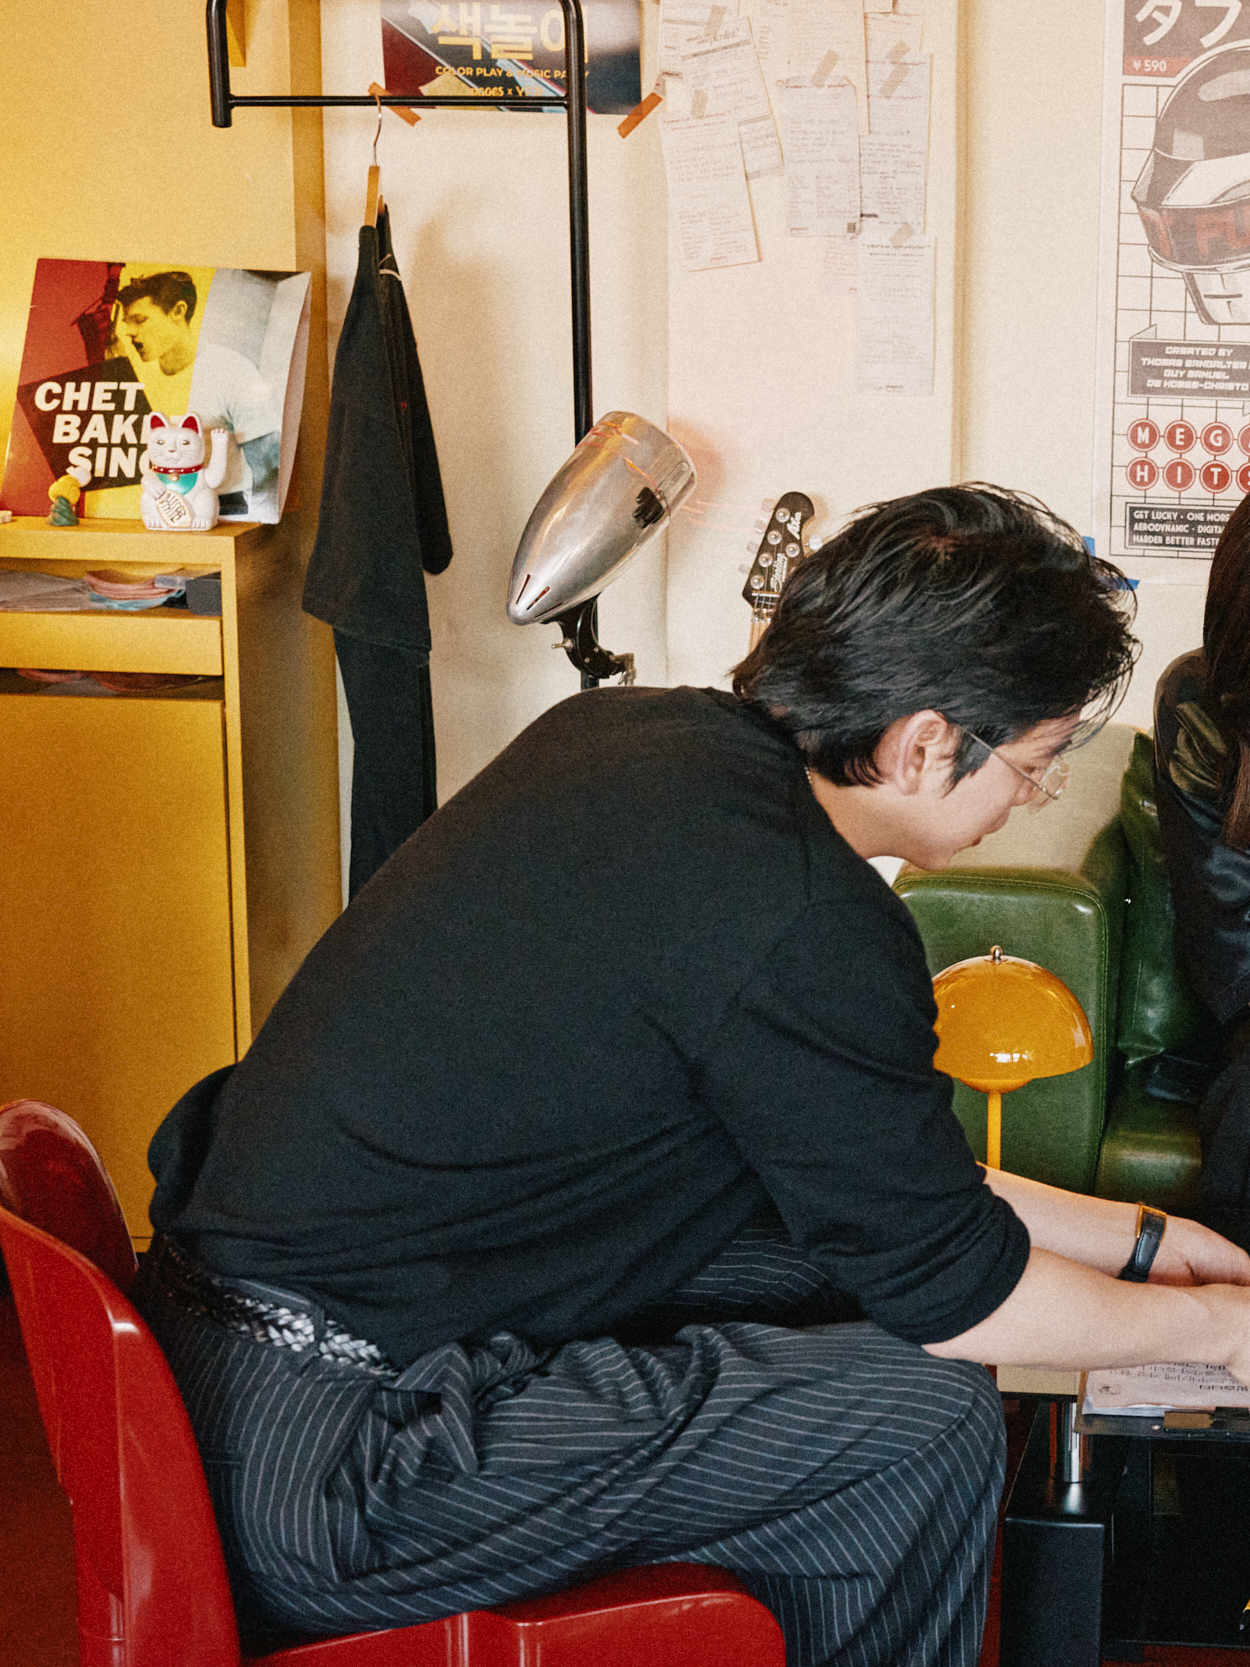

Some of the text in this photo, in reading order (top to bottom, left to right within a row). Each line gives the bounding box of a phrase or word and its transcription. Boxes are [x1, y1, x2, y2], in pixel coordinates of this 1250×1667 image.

[435, 66, 474, 77] COLOR
[476, 67, 503, 77] PLAY
[505, 69, 513, 78] &
[516, 69, 551, 79] MUSIC
[1217, 348, 1234, 357] BY
[34, 381, 145, 412] CHET
[1133, 510, 1149, 520] GET
[1151, 511, 1178, 520] LUCKY
[1186, 512, 1205, 521] ONE
[1133, 522, 1225, 534] AERODYNAMIC DIGITA
[1132, 535, 1163, 544] HARDER
[1165, 536, 1195, 546] BETTER
